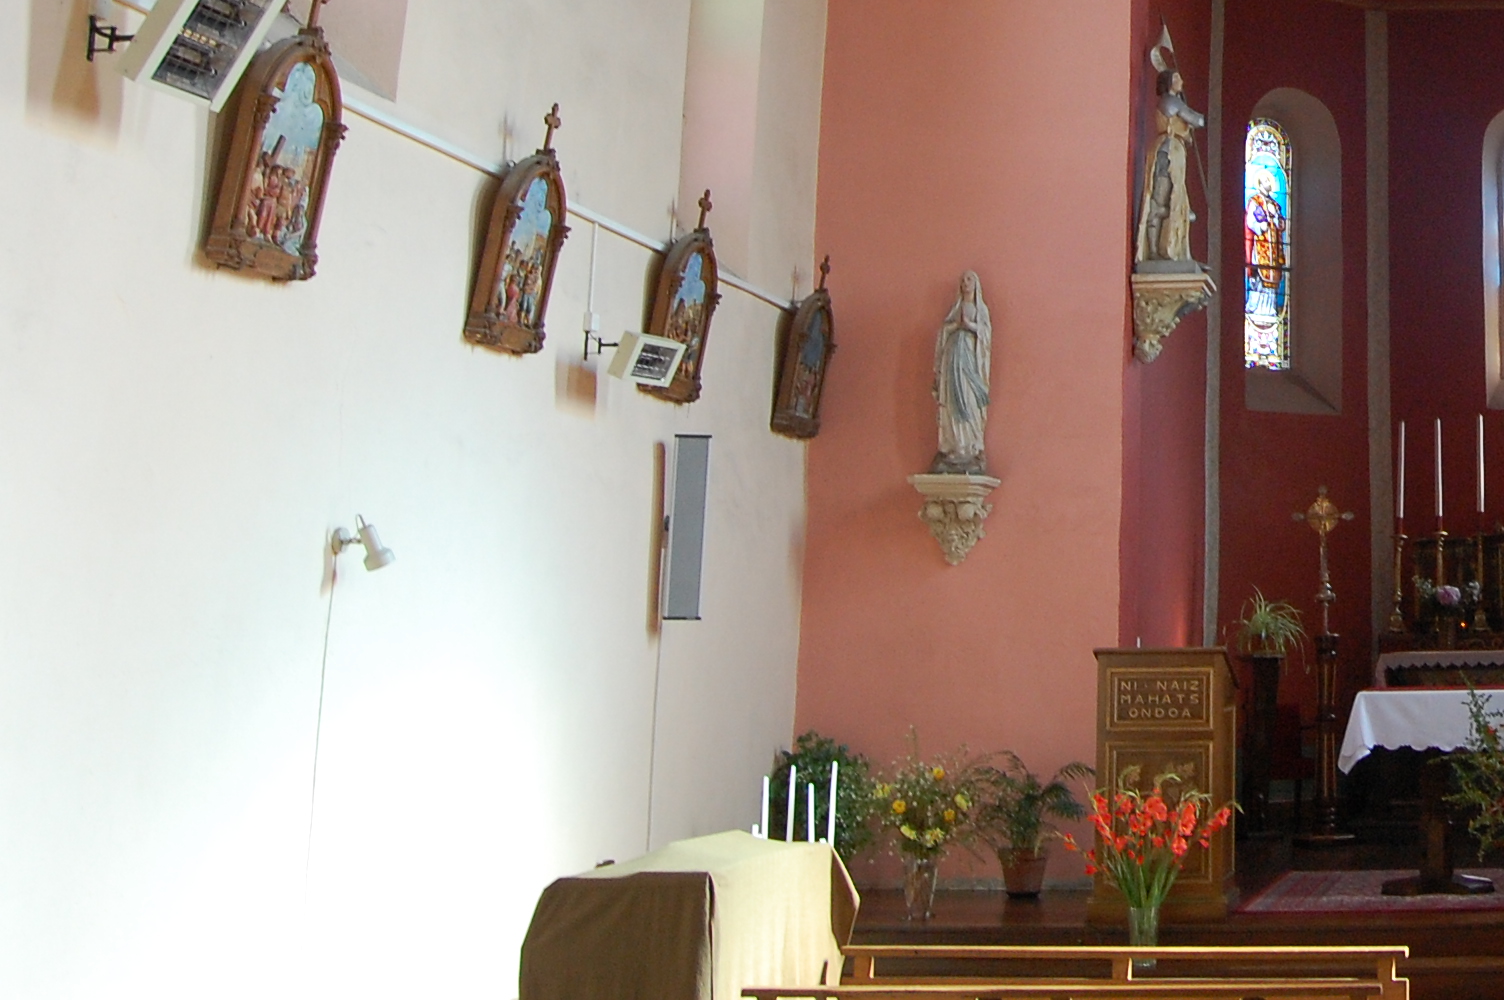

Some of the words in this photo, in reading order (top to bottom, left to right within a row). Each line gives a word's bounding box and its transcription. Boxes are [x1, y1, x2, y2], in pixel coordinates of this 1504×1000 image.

[1120, 681, 1137, 691] NI
[1156, 681, 1199, 691] NAIZ
[1120, 694, 1199, 704] MAHATS
[1128, 708, 1191, 718] ONDOA
